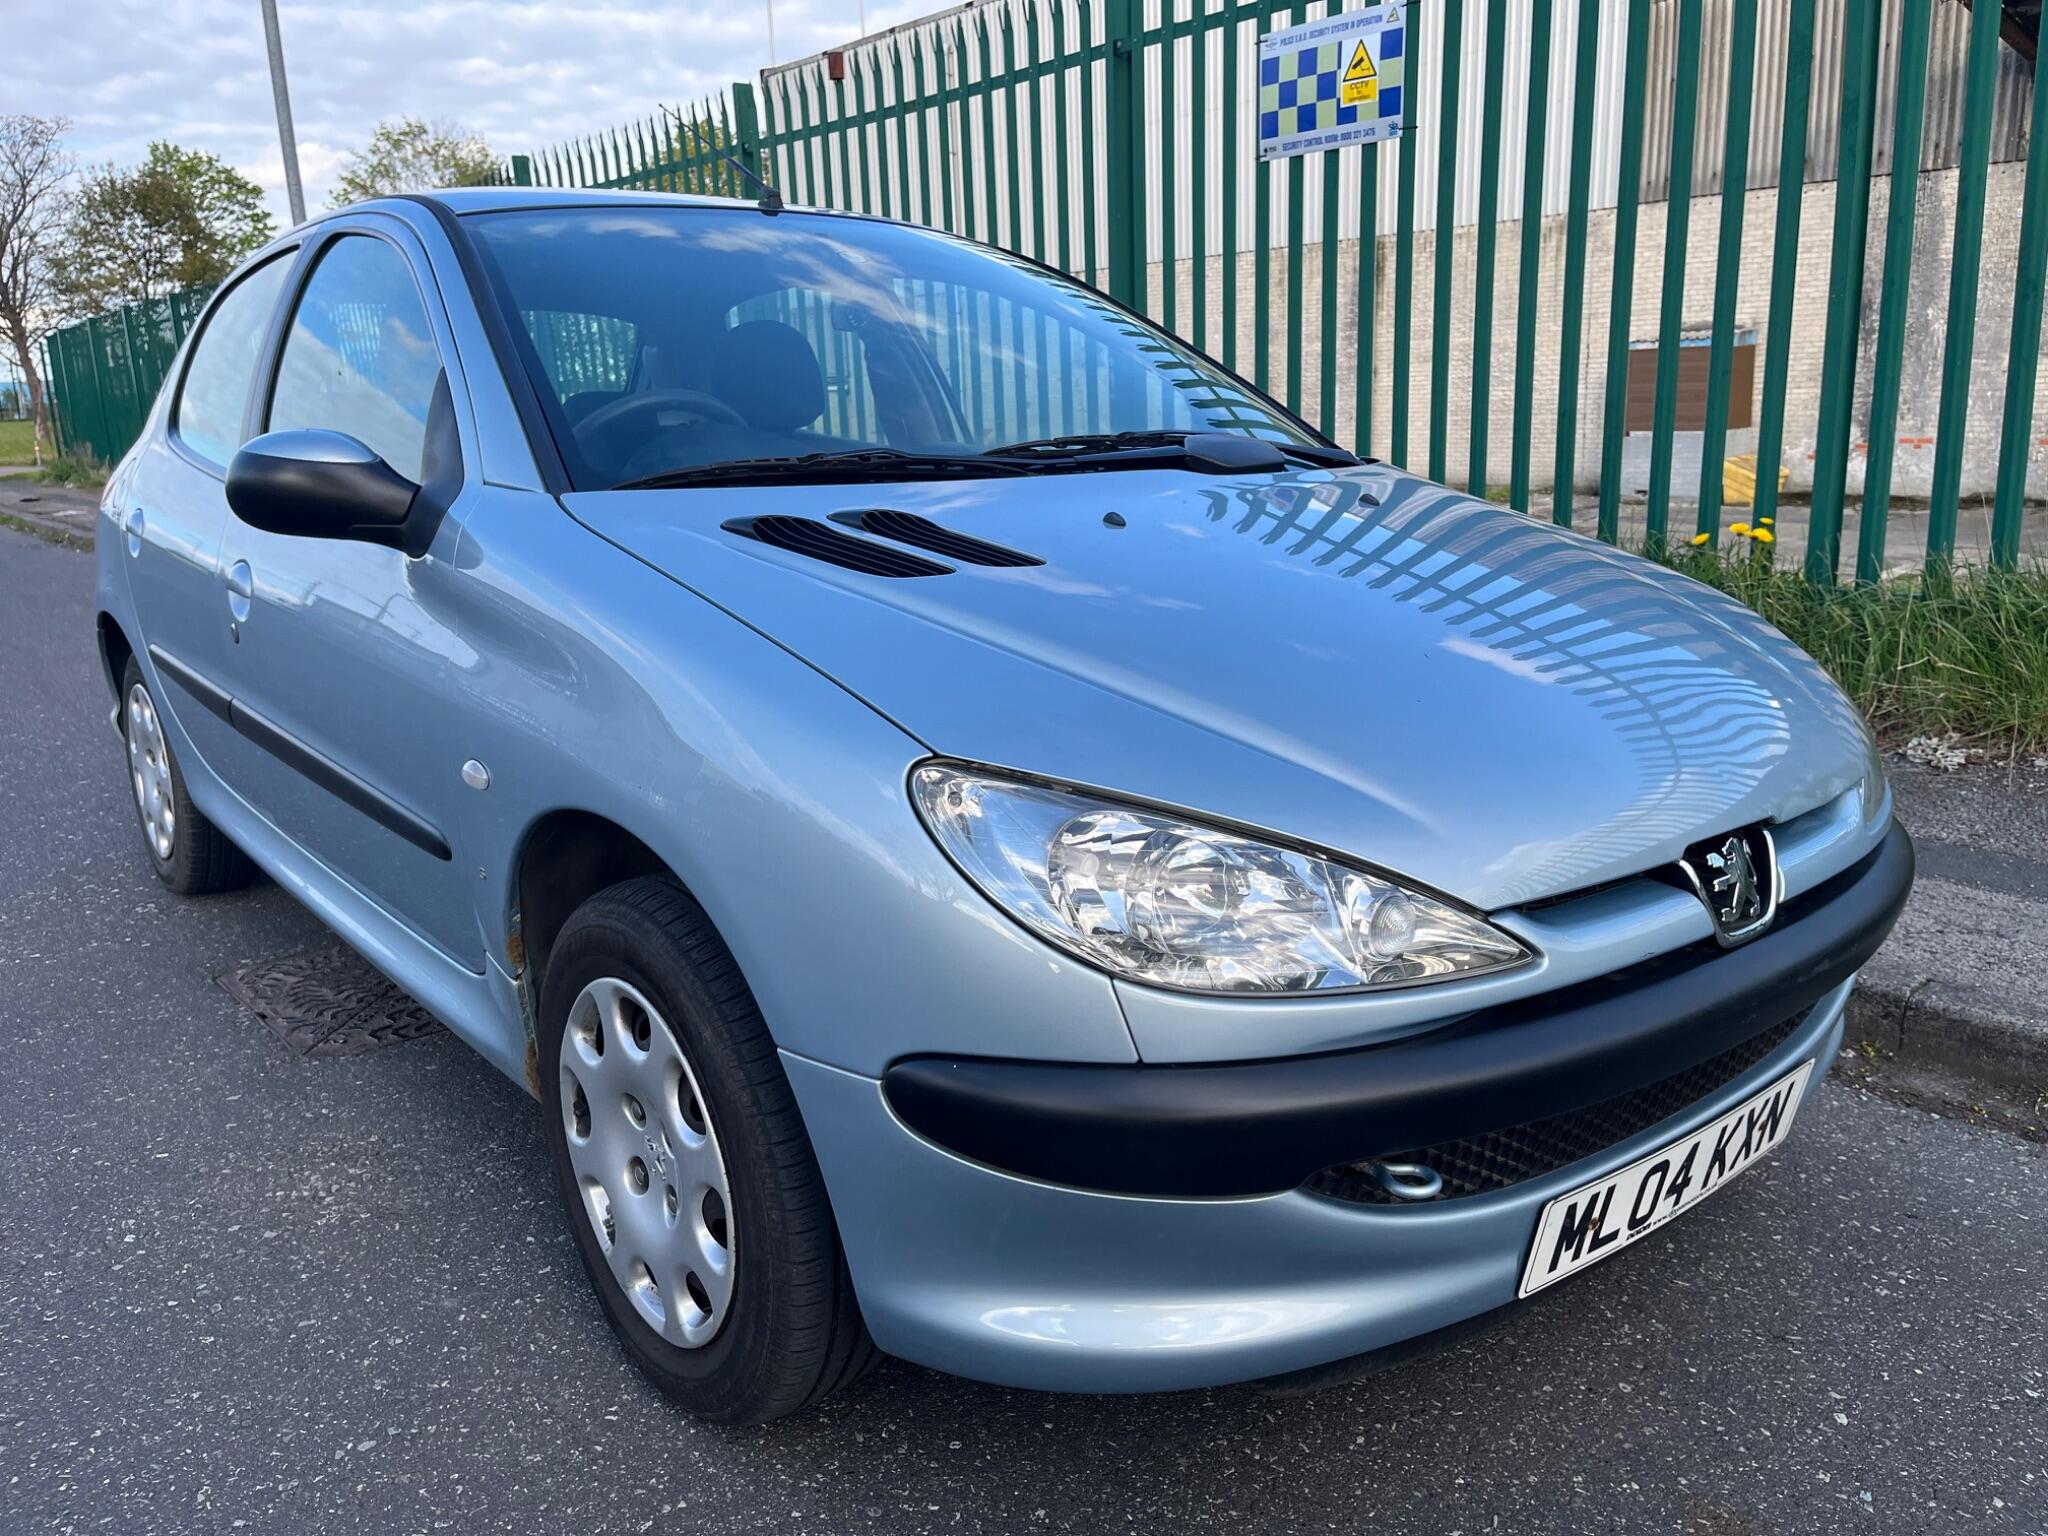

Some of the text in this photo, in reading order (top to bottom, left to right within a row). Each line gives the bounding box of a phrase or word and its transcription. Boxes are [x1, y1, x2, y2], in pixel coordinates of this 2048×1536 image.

[1331, 22, 1349, 34] SYSTEM
[1350, 20, 1355, 29] IN
[1356, 14, 1383, 28] OPERATION
[1349, 80, 1369, 90] CCTV
[1547, 1081, 1796, 1275] ML04 KXN
